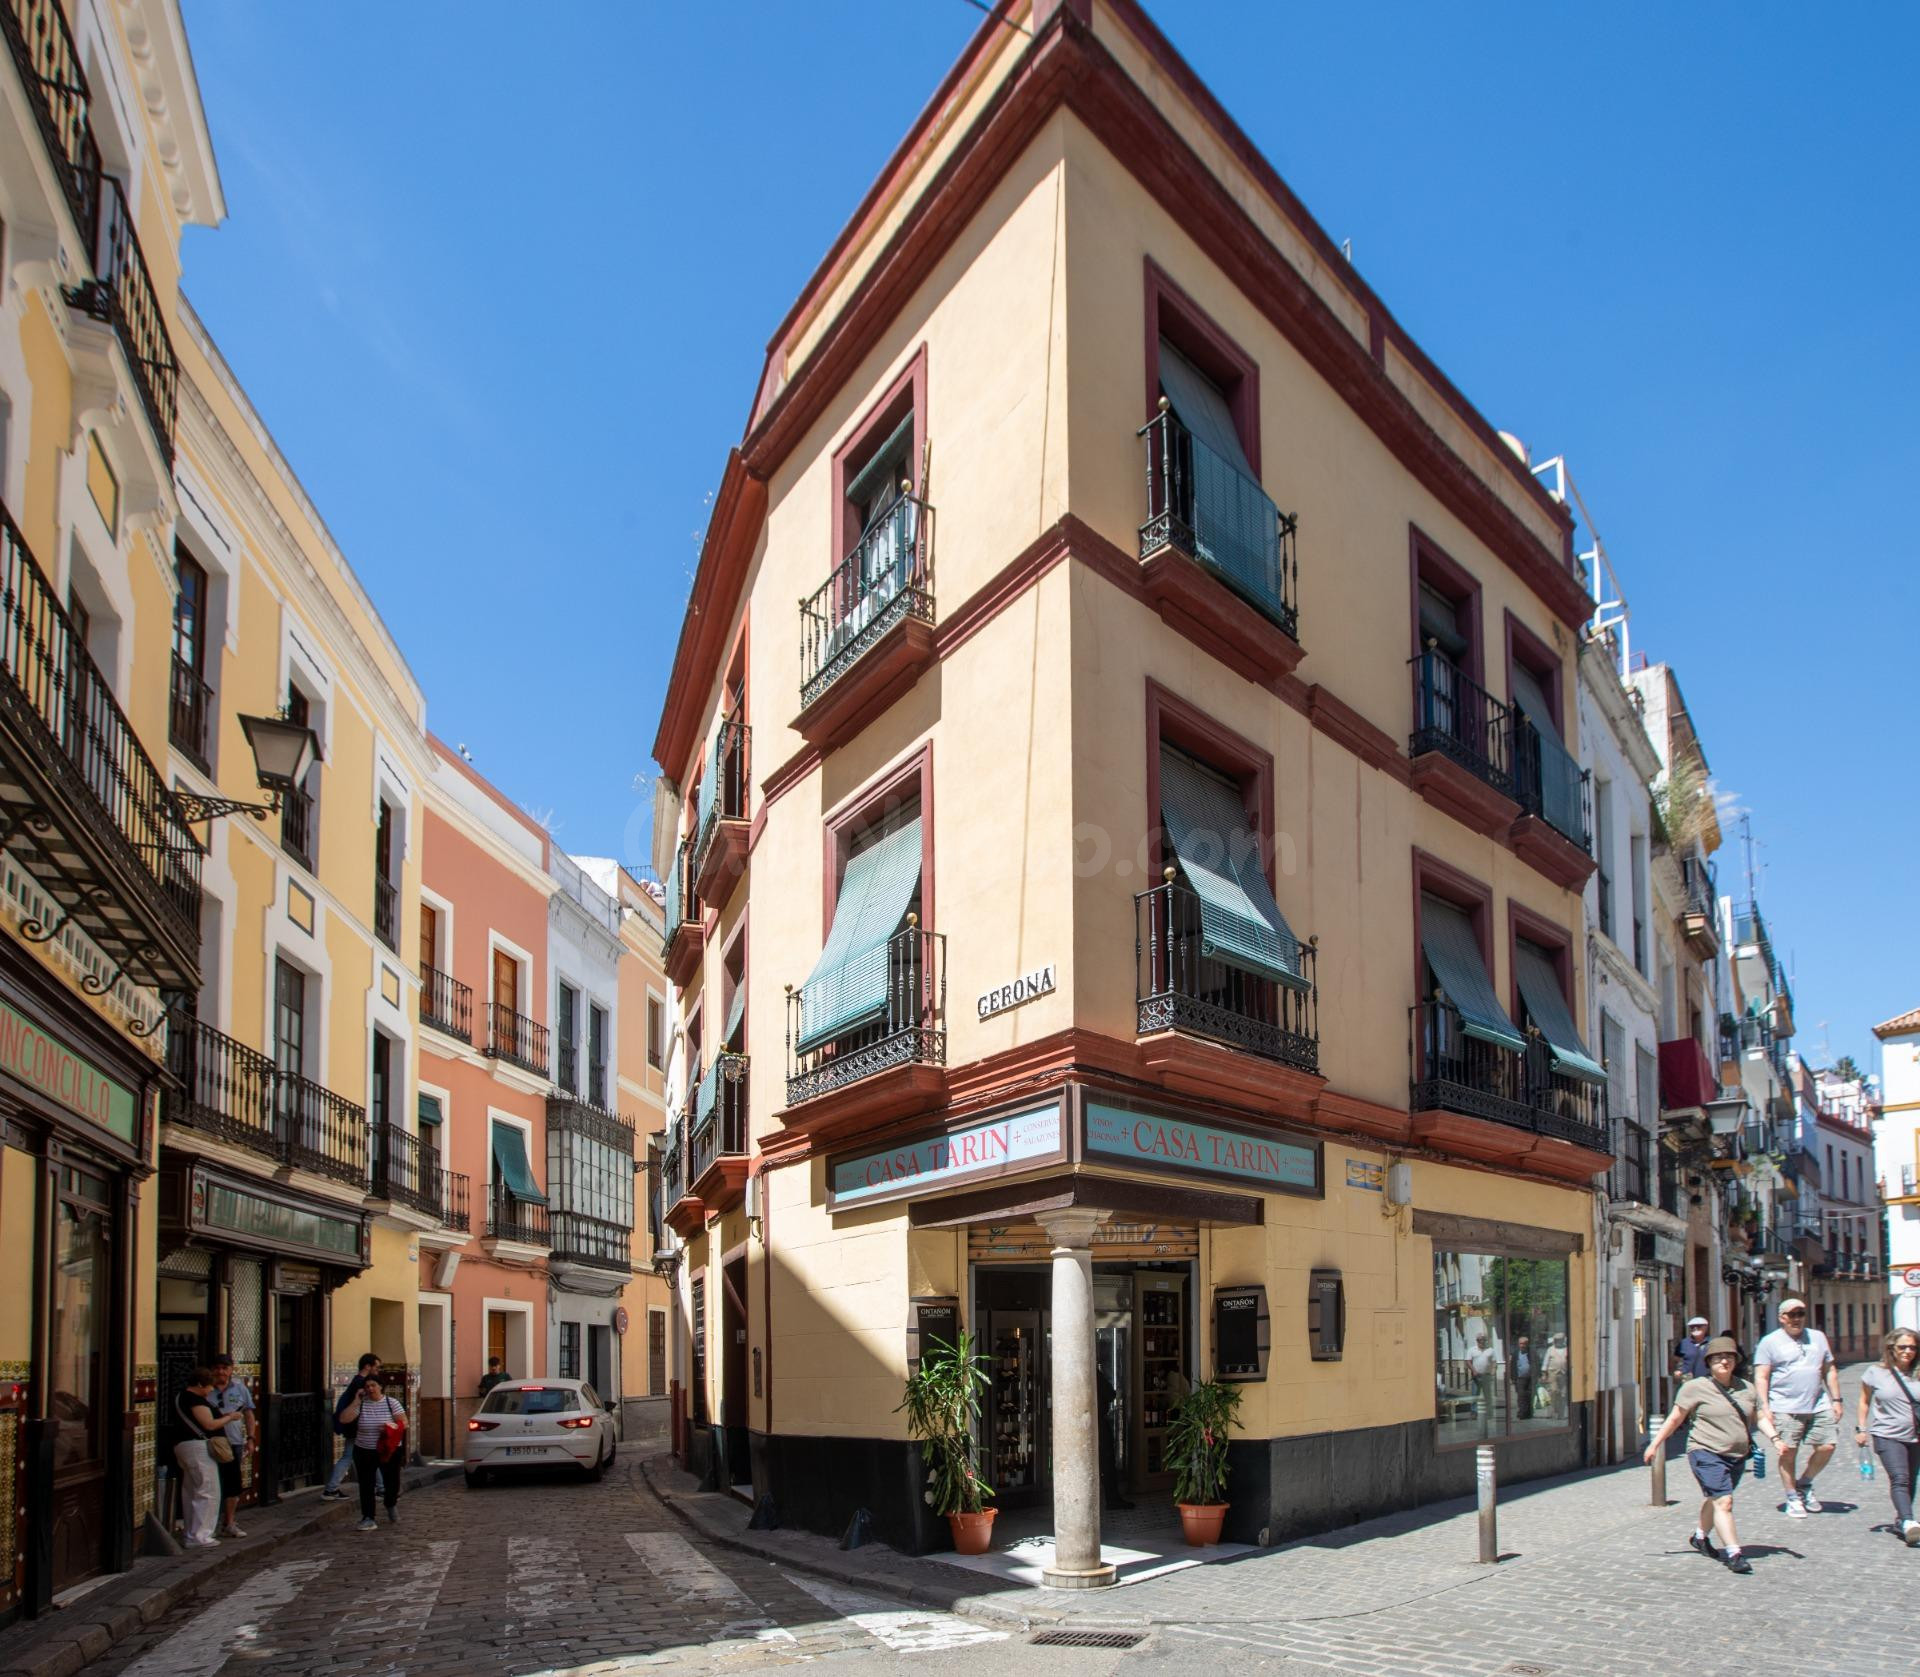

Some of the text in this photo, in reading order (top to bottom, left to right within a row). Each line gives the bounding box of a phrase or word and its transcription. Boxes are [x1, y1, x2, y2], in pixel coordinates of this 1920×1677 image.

[977, 967, 1053, 1017] GERONA
[865, 1125, 1009, 1188] CASA TARIN
[1132, 1120, 1281, 1175] CASA TARIN
